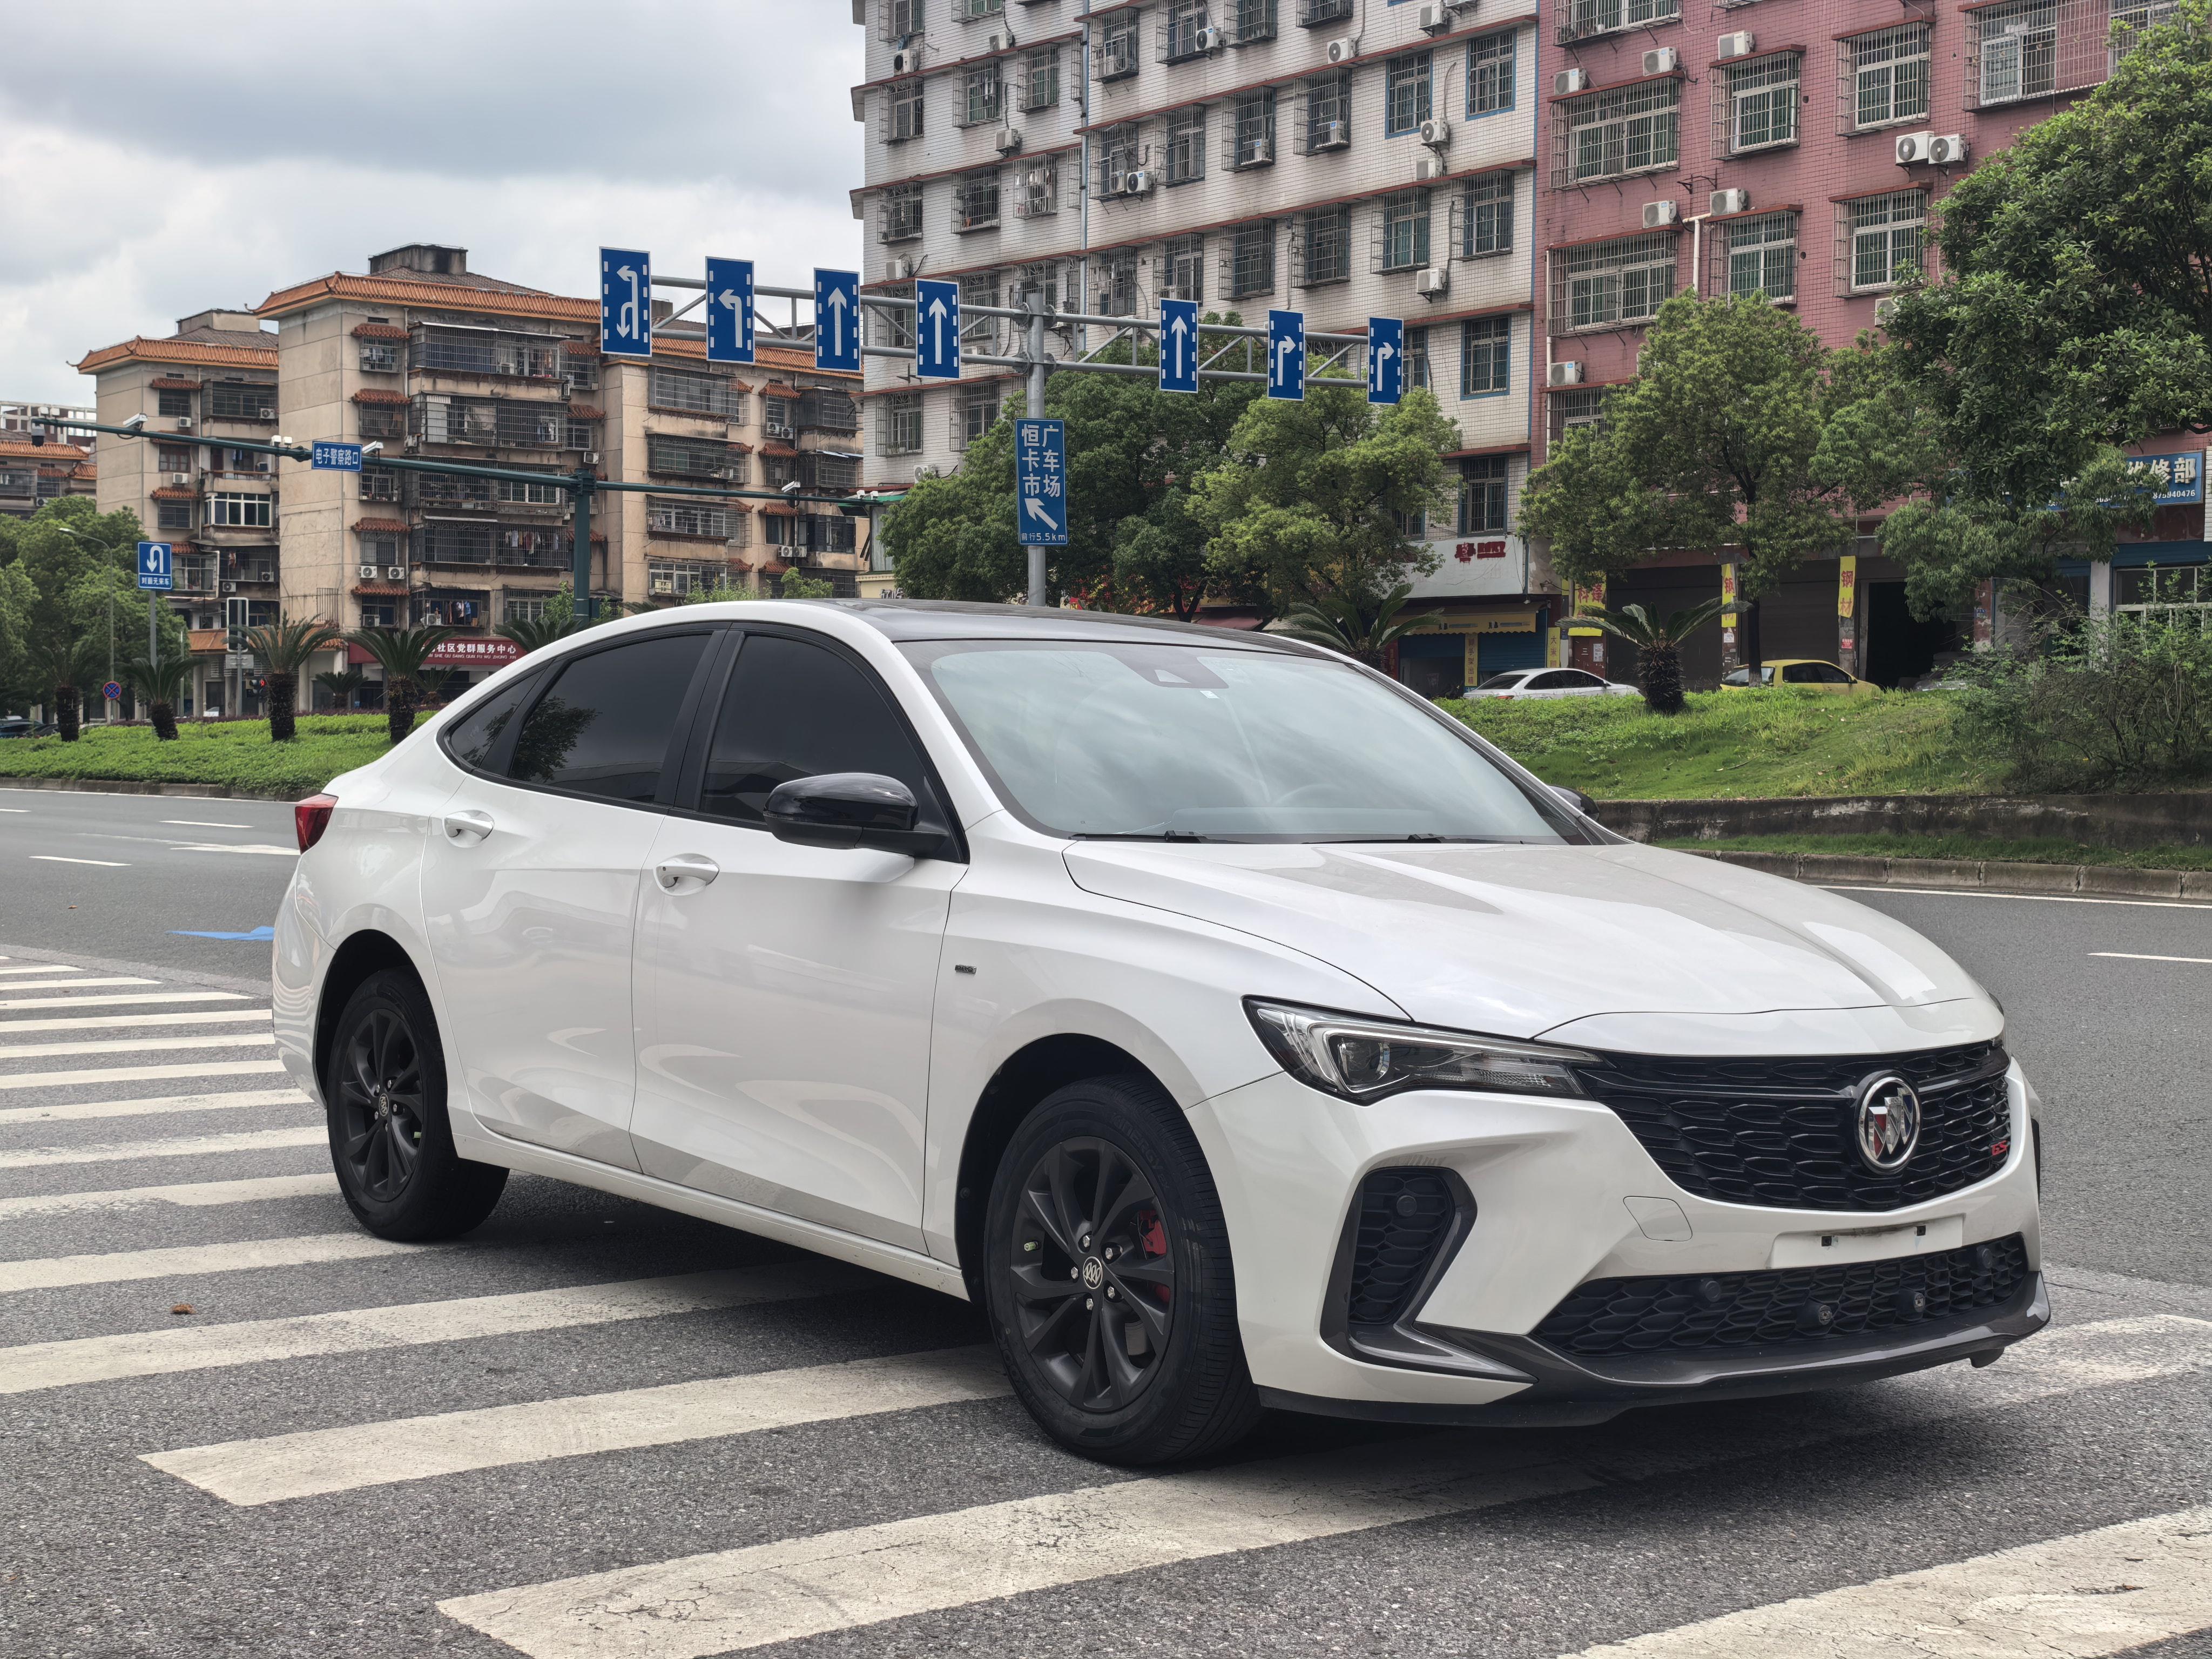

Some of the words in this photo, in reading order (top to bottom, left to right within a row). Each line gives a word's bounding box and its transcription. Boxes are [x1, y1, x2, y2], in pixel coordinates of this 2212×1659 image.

[315, 447, 359, 466] 电子警察路口
[421, 642, 516, 654] 社区党群服务中心
[1991, 1140, 2007, 1156] GS
